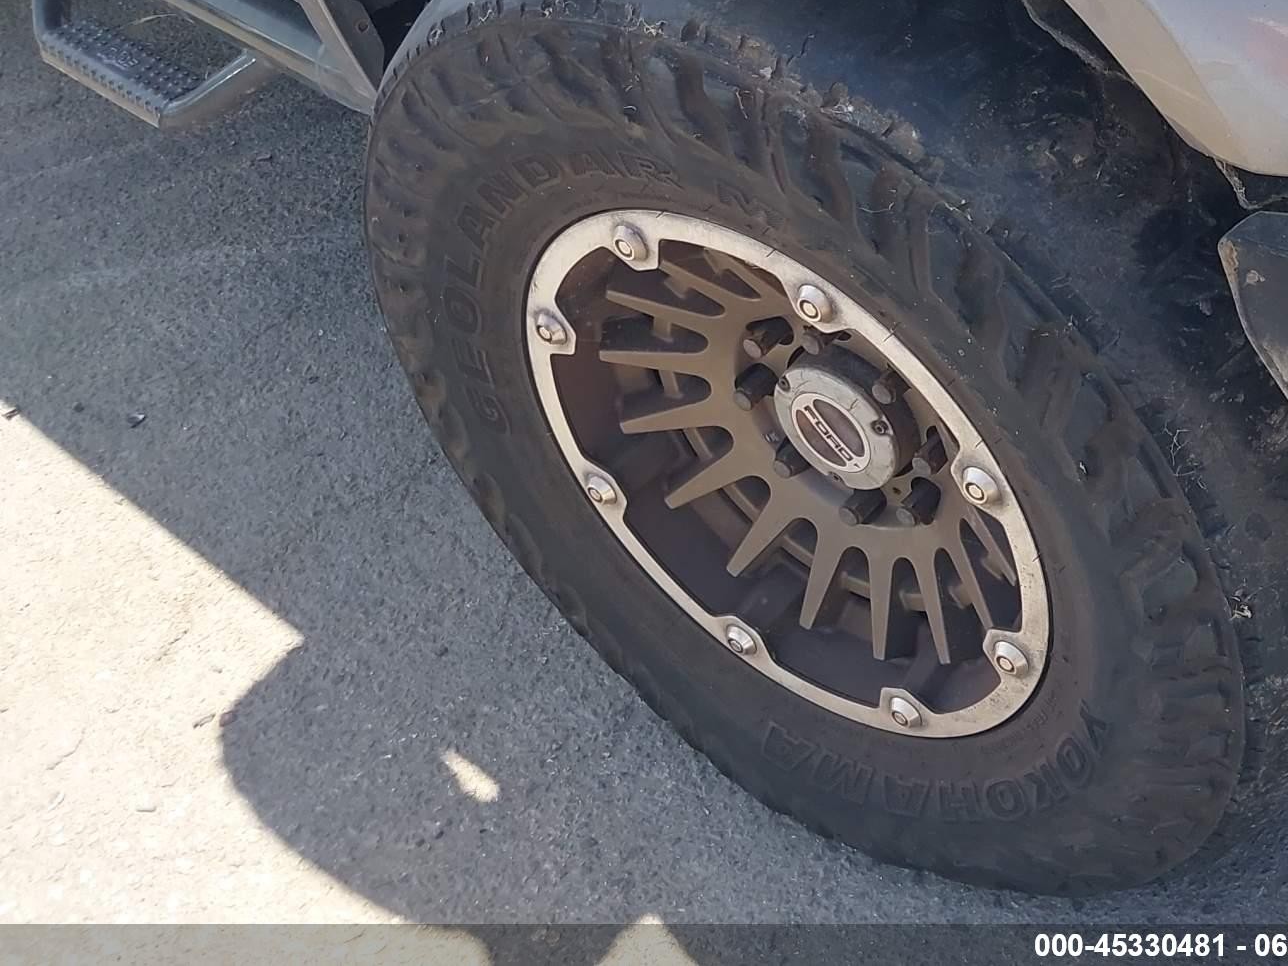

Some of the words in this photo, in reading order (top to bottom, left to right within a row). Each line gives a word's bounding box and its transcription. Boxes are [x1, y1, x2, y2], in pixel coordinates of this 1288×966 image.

[440, 151, 685, 436] GEOLANDAR
[803, 404, 854, 462] FORD
[760, 697, 1109, 821] YOKOHAMA
